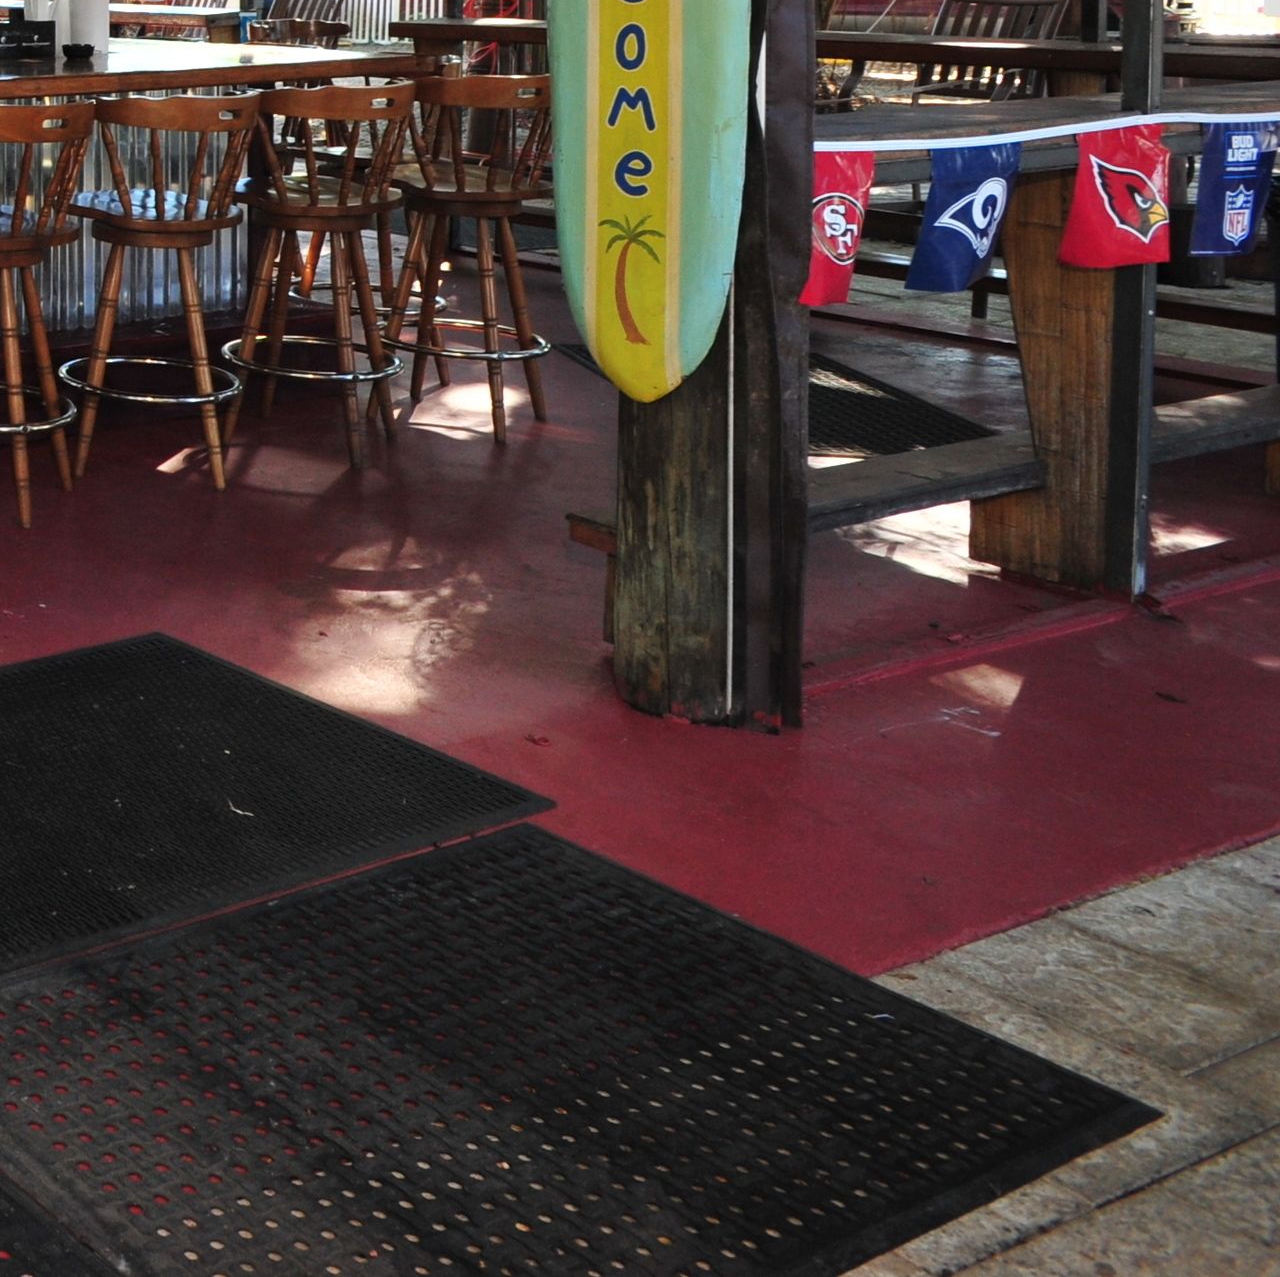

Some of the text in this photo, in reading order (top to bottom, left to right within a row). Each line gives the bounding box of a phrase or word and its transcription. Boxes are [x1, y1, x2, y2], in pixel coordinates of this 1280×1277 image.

[1231, 133, 1255, 148] BUD
[1226, 146, 1259, 163] LIGHT
[1226, 209, 1250, 236] NFL
